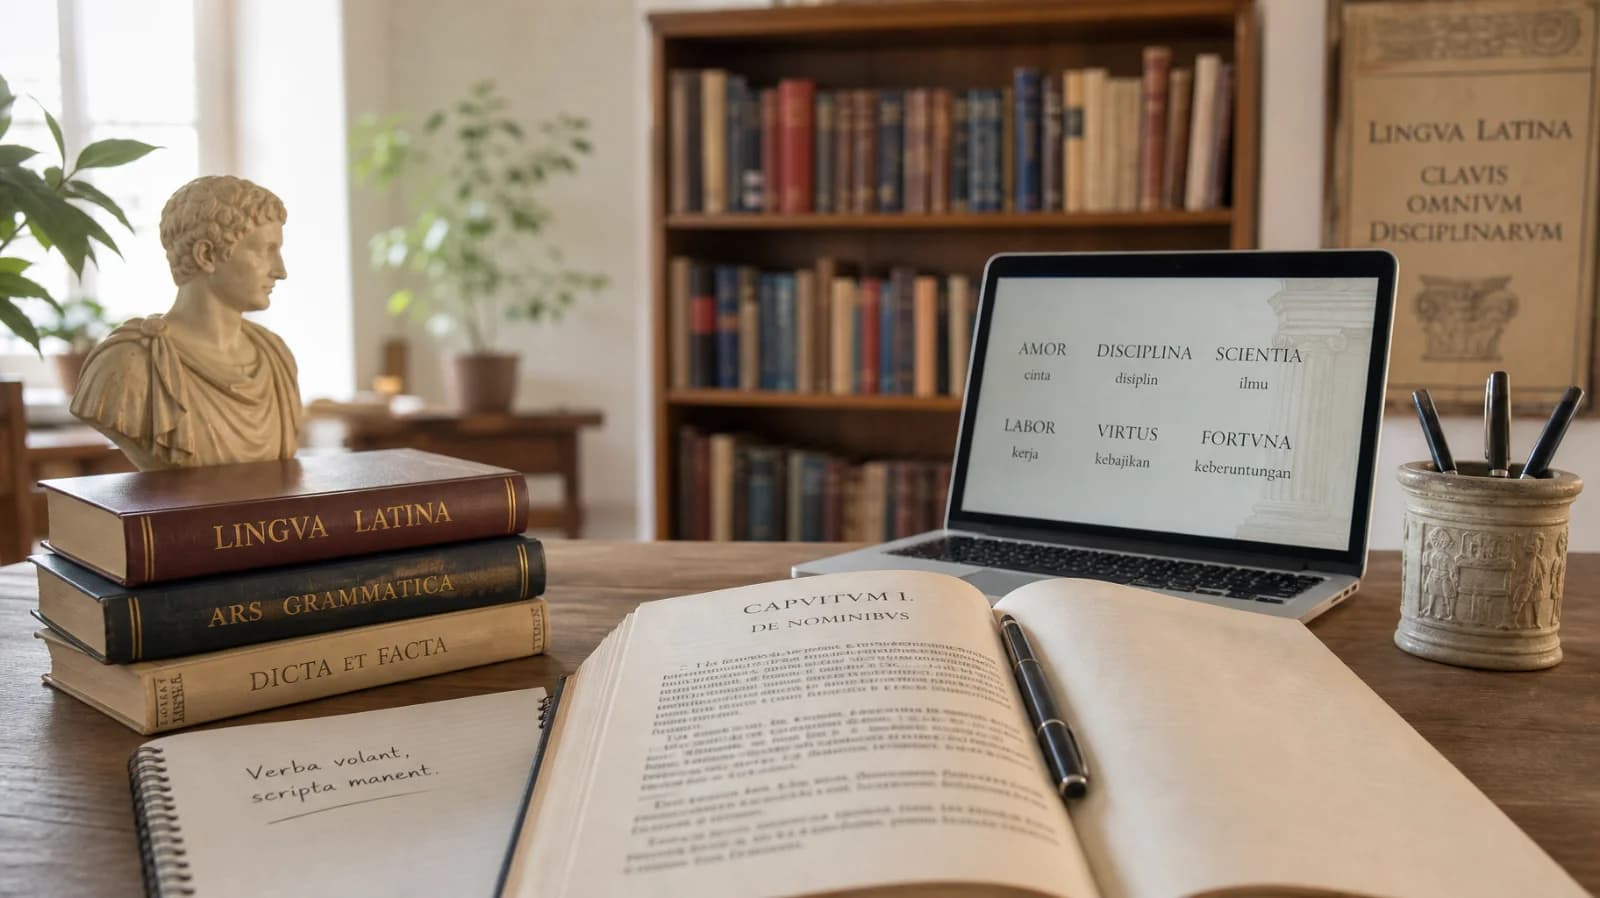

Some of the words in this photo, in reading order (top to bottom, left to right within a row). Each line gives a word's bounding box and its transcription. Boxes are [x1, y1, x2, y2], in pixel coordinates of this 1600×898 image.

[1369, 120, 1464, 144] LINGVA
[1476, 119, 1573, 142] LATINA
[1421, 165, 1508, 185] CLAVIS
[1407, 194, 1522, 214] OMNIVM
[1369, 221, 1563, 244] DISCIPLINARVM
[1018, 342, 1067, 357] AMOR
[1097, 344, 1193, 360] DISCIPLINA
[1215, 347, 1303, 363] SCIENTIA
[1024, 370, 1051, 382] cinta
[1115, 372, 1158, 388] disiplin
[1239, 377, 1269, 390] ilmu
[1005, 419, 1055, 435] LABOR
[1097, 424, 1159, 441] VIRTUS
[1201, 431, 1292, 450] FORTVNA
[1012, 446, 1039, 462] kerja
[1095, 452, 1150, 470] kebajikan
[1194, 460, 1291, 481] keberuntungan
[213, 514, 328, 550] LINGVA
[354, 500, 453, 533] LATINA
[209, 601, 262, 627] ARS
[283, 574, 454, 615] GRAMMATICA
[752, 621, 779, 633] DE
[788, 611, 910, 628] NOMINIBVS
[250, 659, 332, 691] DICTA
[343, 653, 366, 671] ET
[378, 637, 449, 666] FACTA
[246, 760, 321, 780] Verba
[334, 746, 410, 767] volant,
[252, 782, 336, 804] scripta
[349, 764, 440, 788] manent.
